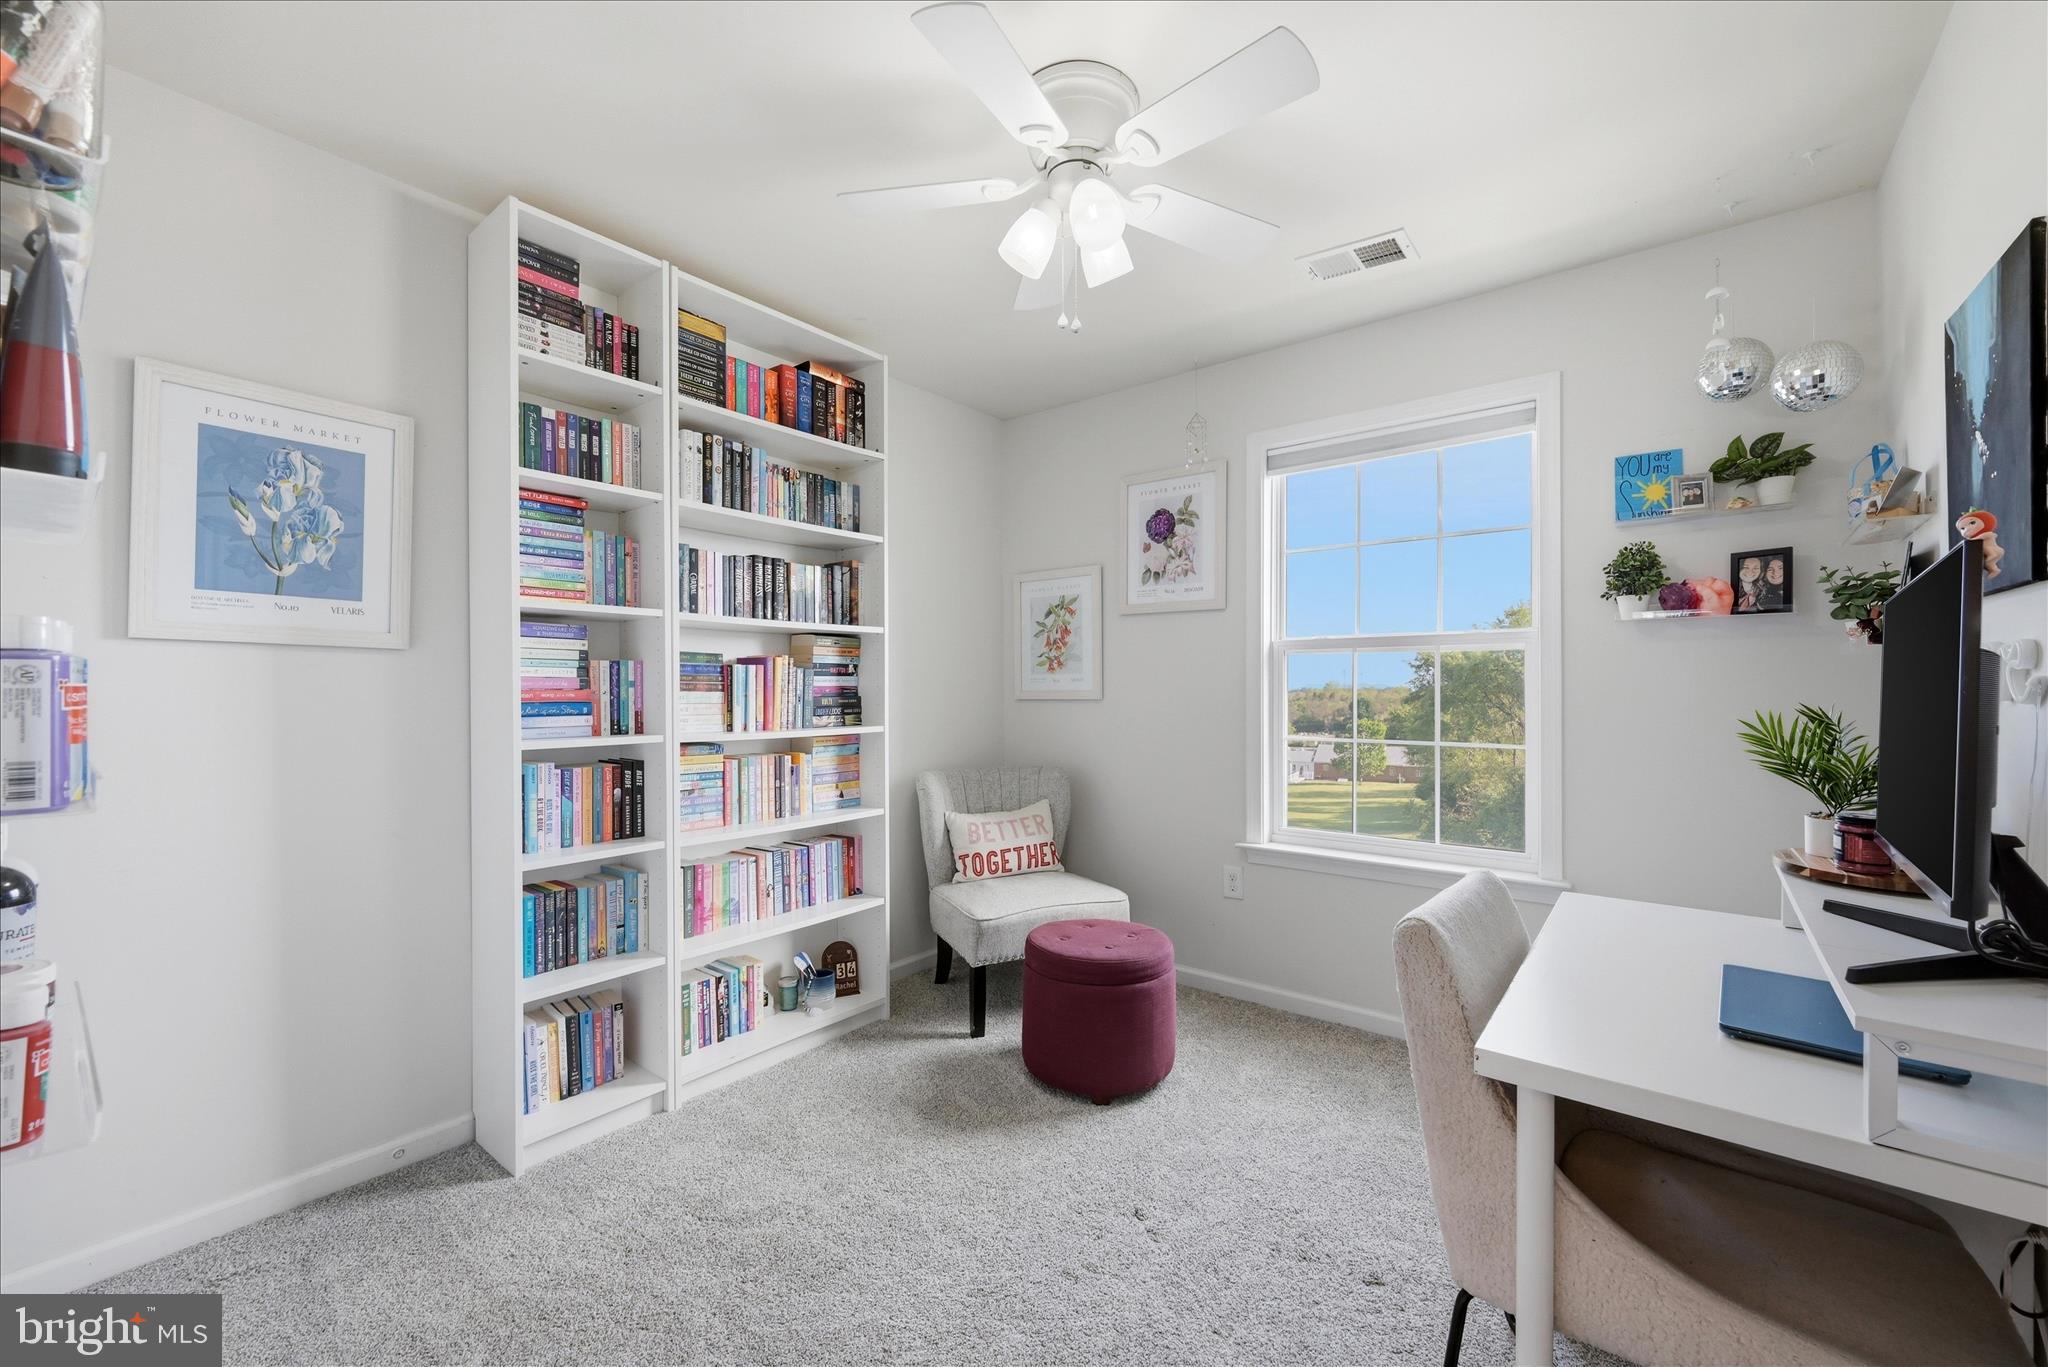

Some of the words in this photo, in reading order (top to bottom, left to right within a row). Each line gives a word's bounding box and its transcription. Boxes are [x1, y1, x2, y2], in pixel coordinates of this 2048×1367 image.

[204, 406, 281, 429] FLOWER
[293, 424, 362, 445] MARKET
[1616, 455, 1652, 480] YOU
[1653, 451, 1673, 463] are
[1653, 464, 1669, 475] my
[331, 606, 366, 616] VELARIS
[967, 814, 1049, 845] BETTER
[958, 841, 1062, 878] TOGETHER
